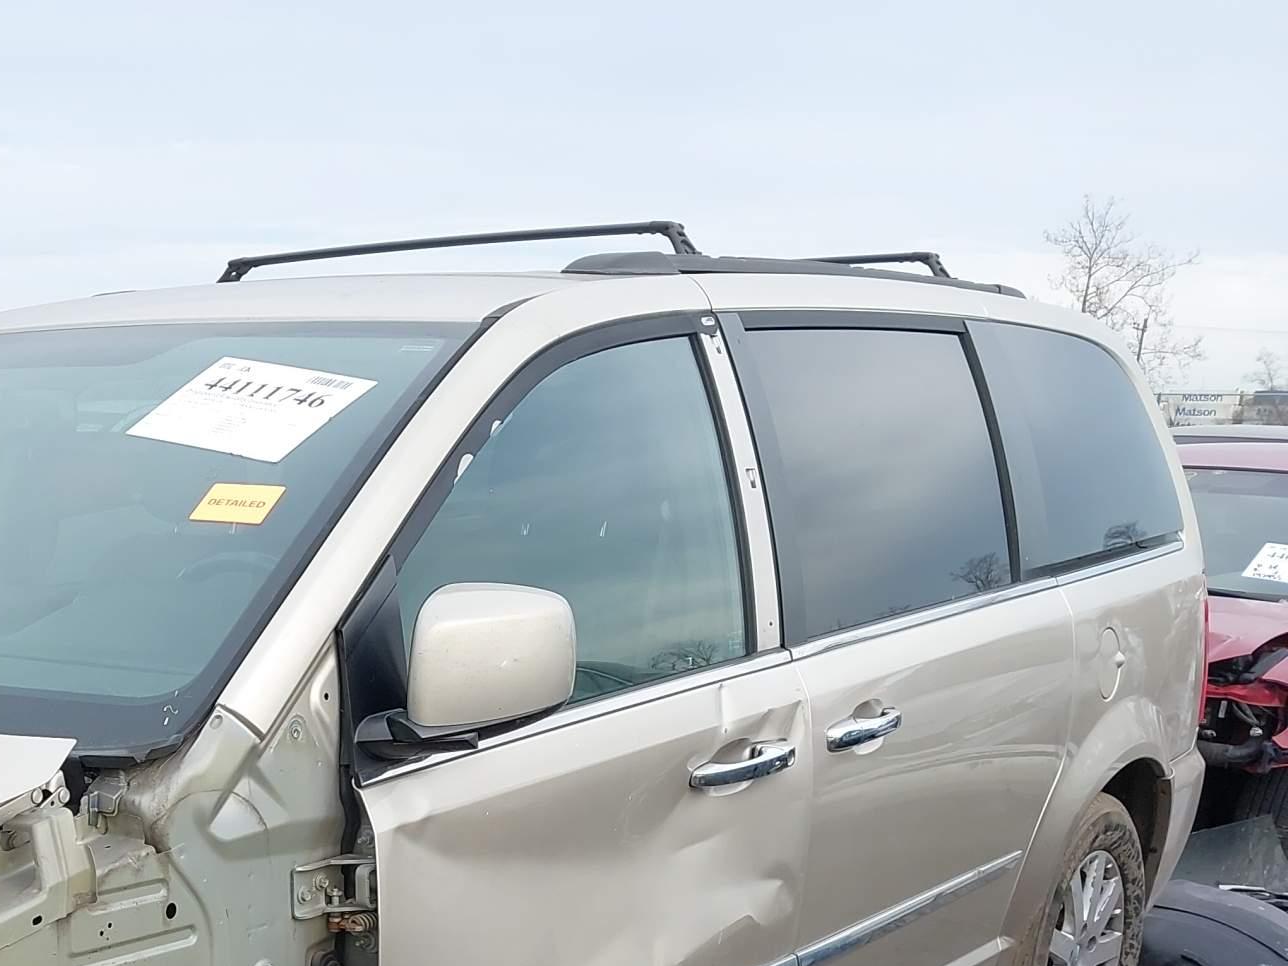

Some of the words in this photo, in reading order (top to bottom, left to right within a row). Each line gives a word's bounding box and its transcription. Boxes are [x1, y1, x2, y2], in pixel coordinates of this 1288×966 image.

[204, 376, 332, 408] 44111746
[1175, 407, 1217, 416] Matson
[207, 497, 266, 510] DETAILED
